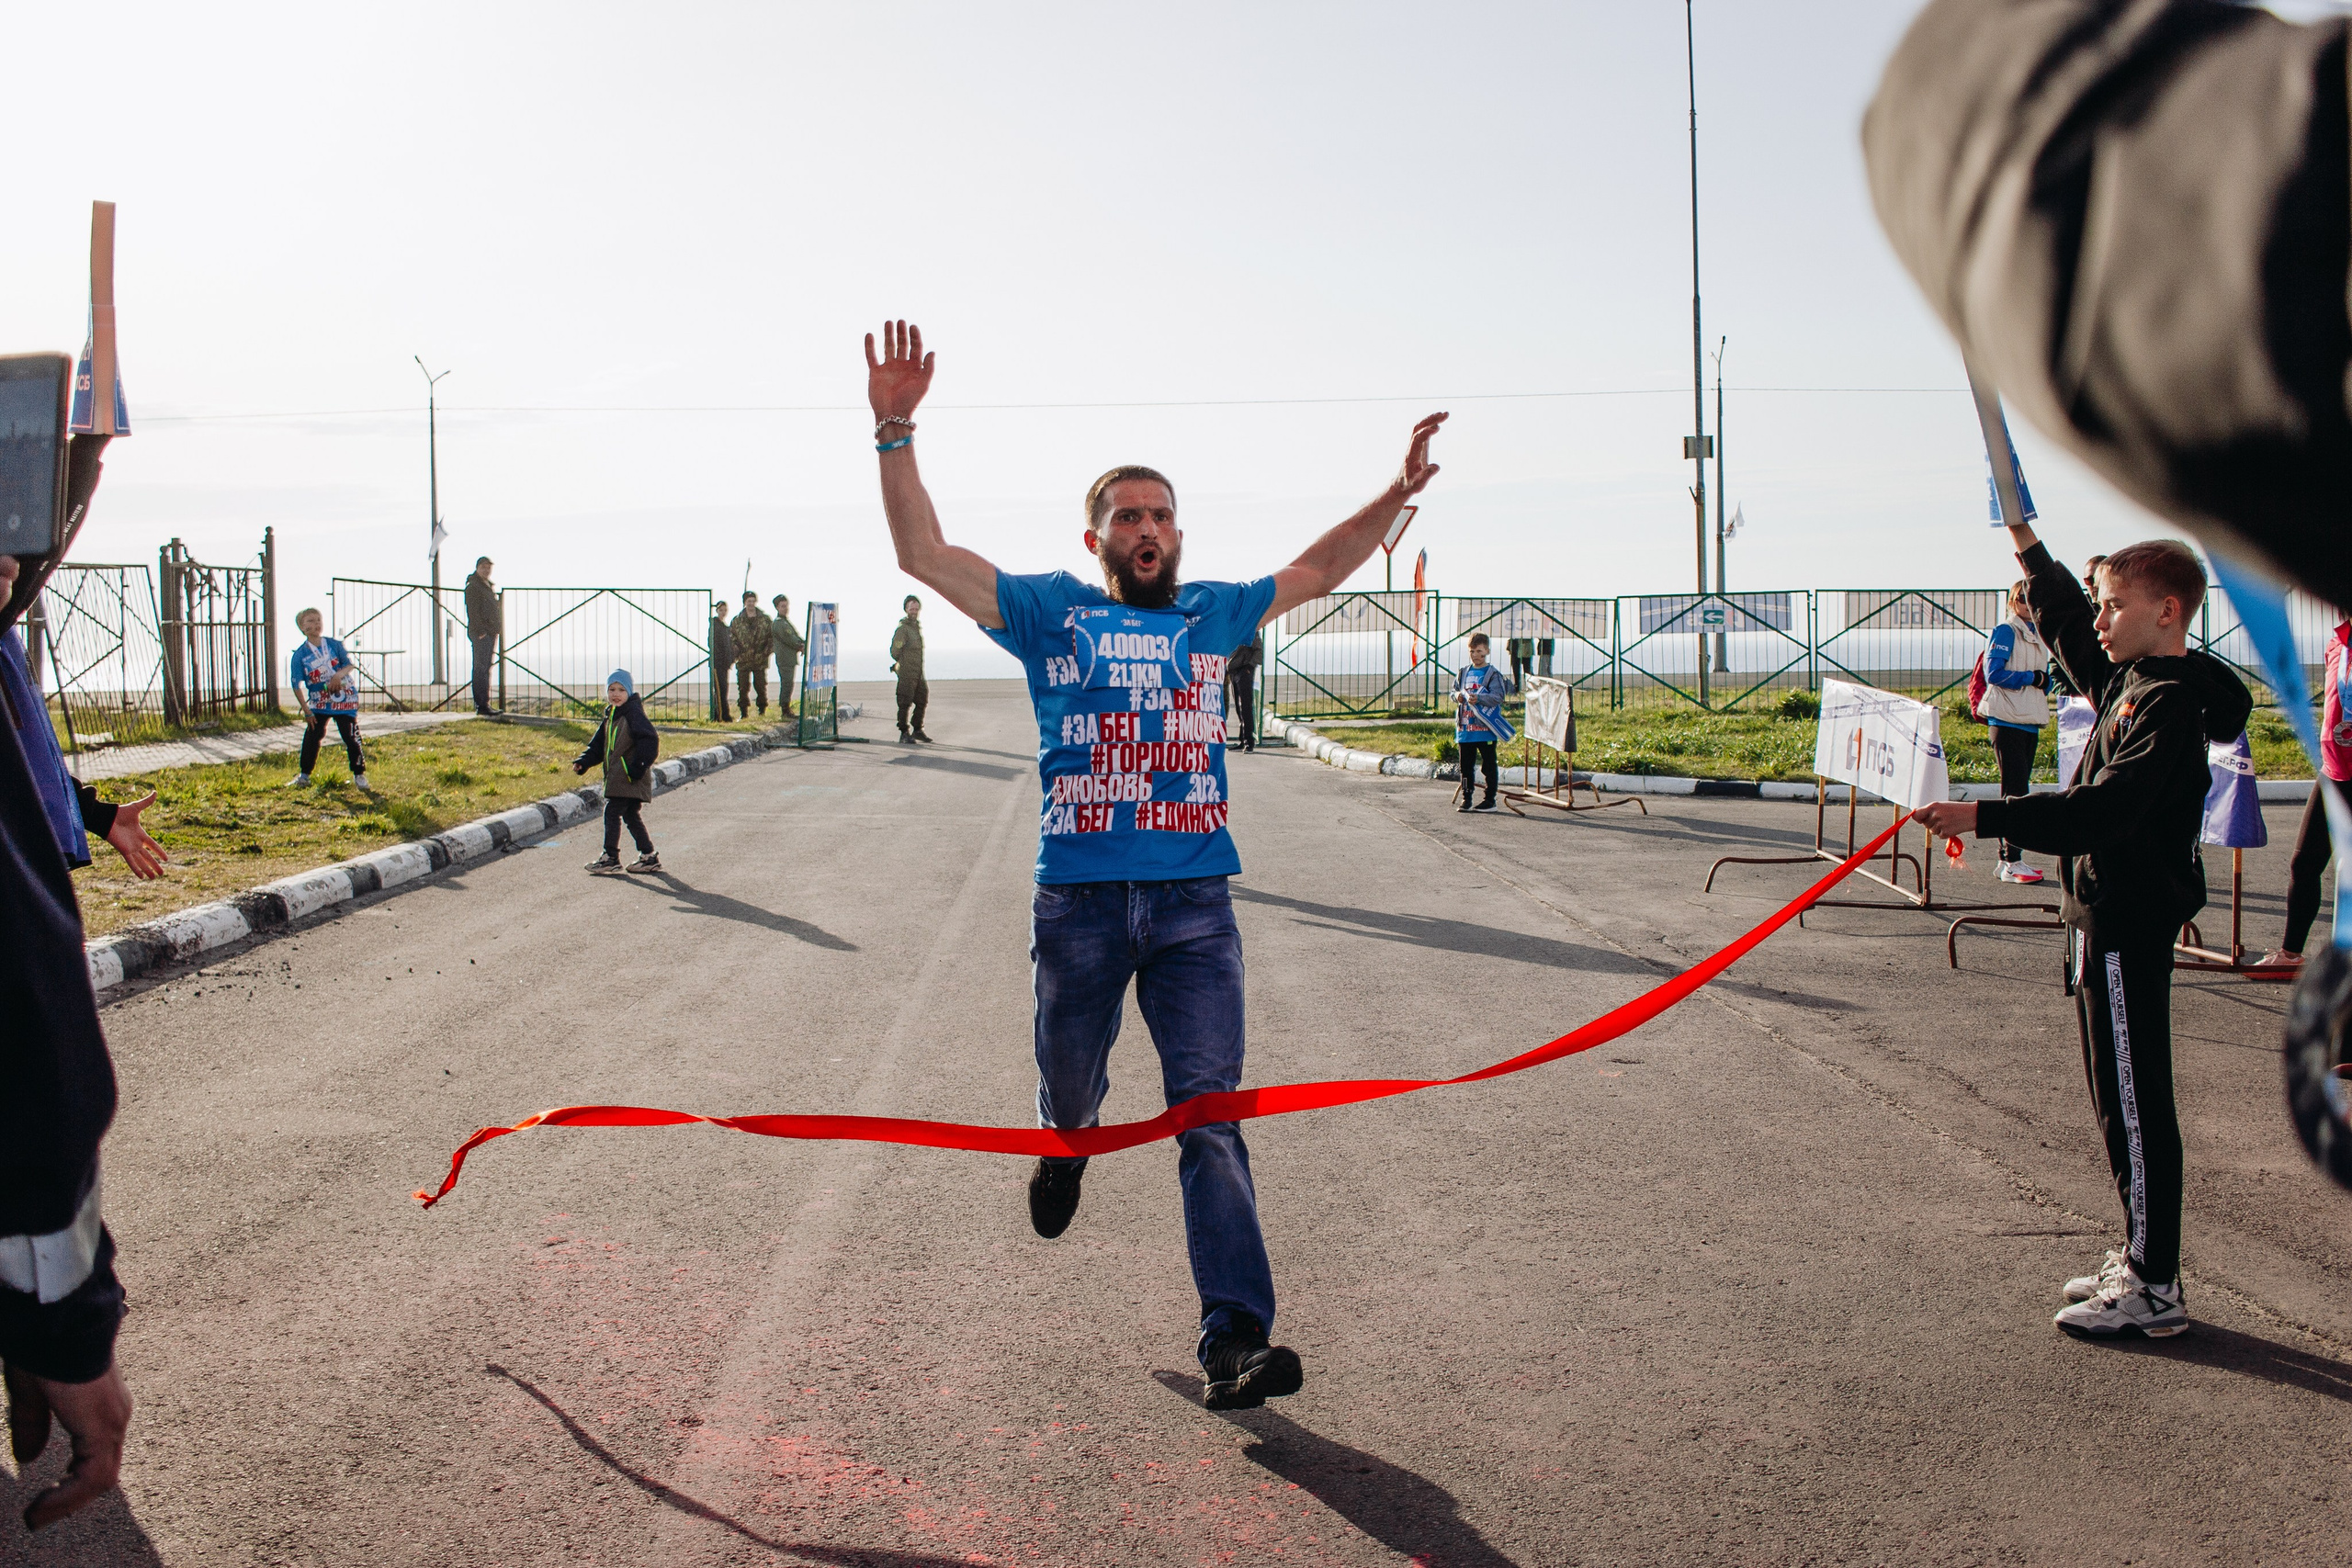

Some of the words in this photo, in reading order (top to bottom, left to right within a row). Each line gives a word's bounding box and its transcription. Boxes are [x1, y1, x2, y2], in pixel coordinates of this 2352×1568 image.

[1091, 609, 1109, 618] ПСБ
[1098, 633, 1170, 660] 40003
[1061, 712, 1141, 745] #ЗАБЕГ
[1091, 742, 1210, 773] #ГОРДОСТЬ
[1865, 738, 1894, 778] ПСБ
[1051, 773, 1153, 805] #ЛЮБОВЬ
[1042, 803, 1115, 836] #ЗАБЕГ
[2112, 969, 2121, 988] OPEN
[2115, 989, 2125, 1025] YOURSELF
[2123, 1066, 2132, 1085] OPEN
[2125, 1087, 2137, 1121] YOURSELF
[2135, 1160, 2143, 1179] OPEN
[2136, 1181, 2144, 1215] YOURSELF
